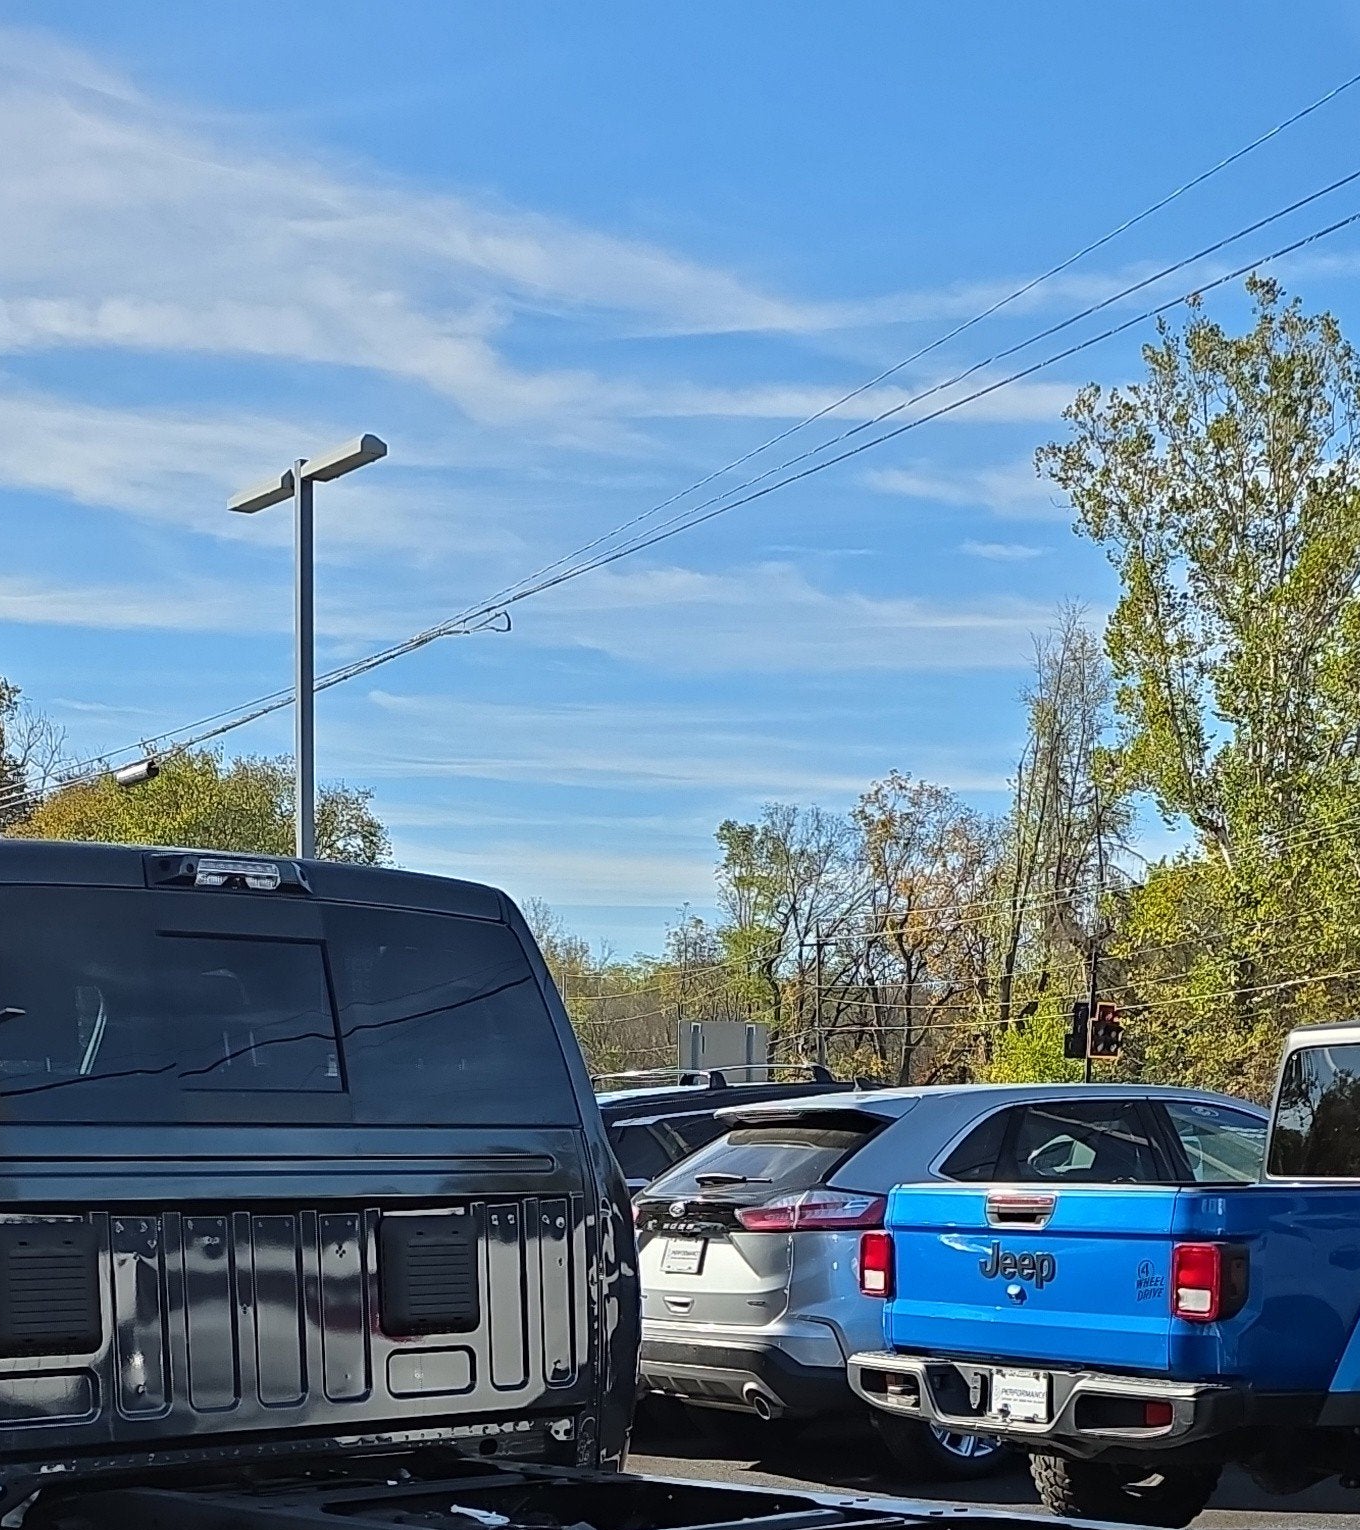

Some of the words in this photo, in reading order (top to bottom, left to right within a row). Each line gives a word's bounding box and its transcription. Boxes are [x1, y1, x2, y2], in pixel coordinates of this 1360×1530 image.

[979, 1240, 1056, 1289] Jeep
[1136, 1276, 1165, 1289] WHEEL
[1137, 1288, 1165, 1302] DRIVE
[1001, 1388, 1046, 1399] PERFORMANCE
